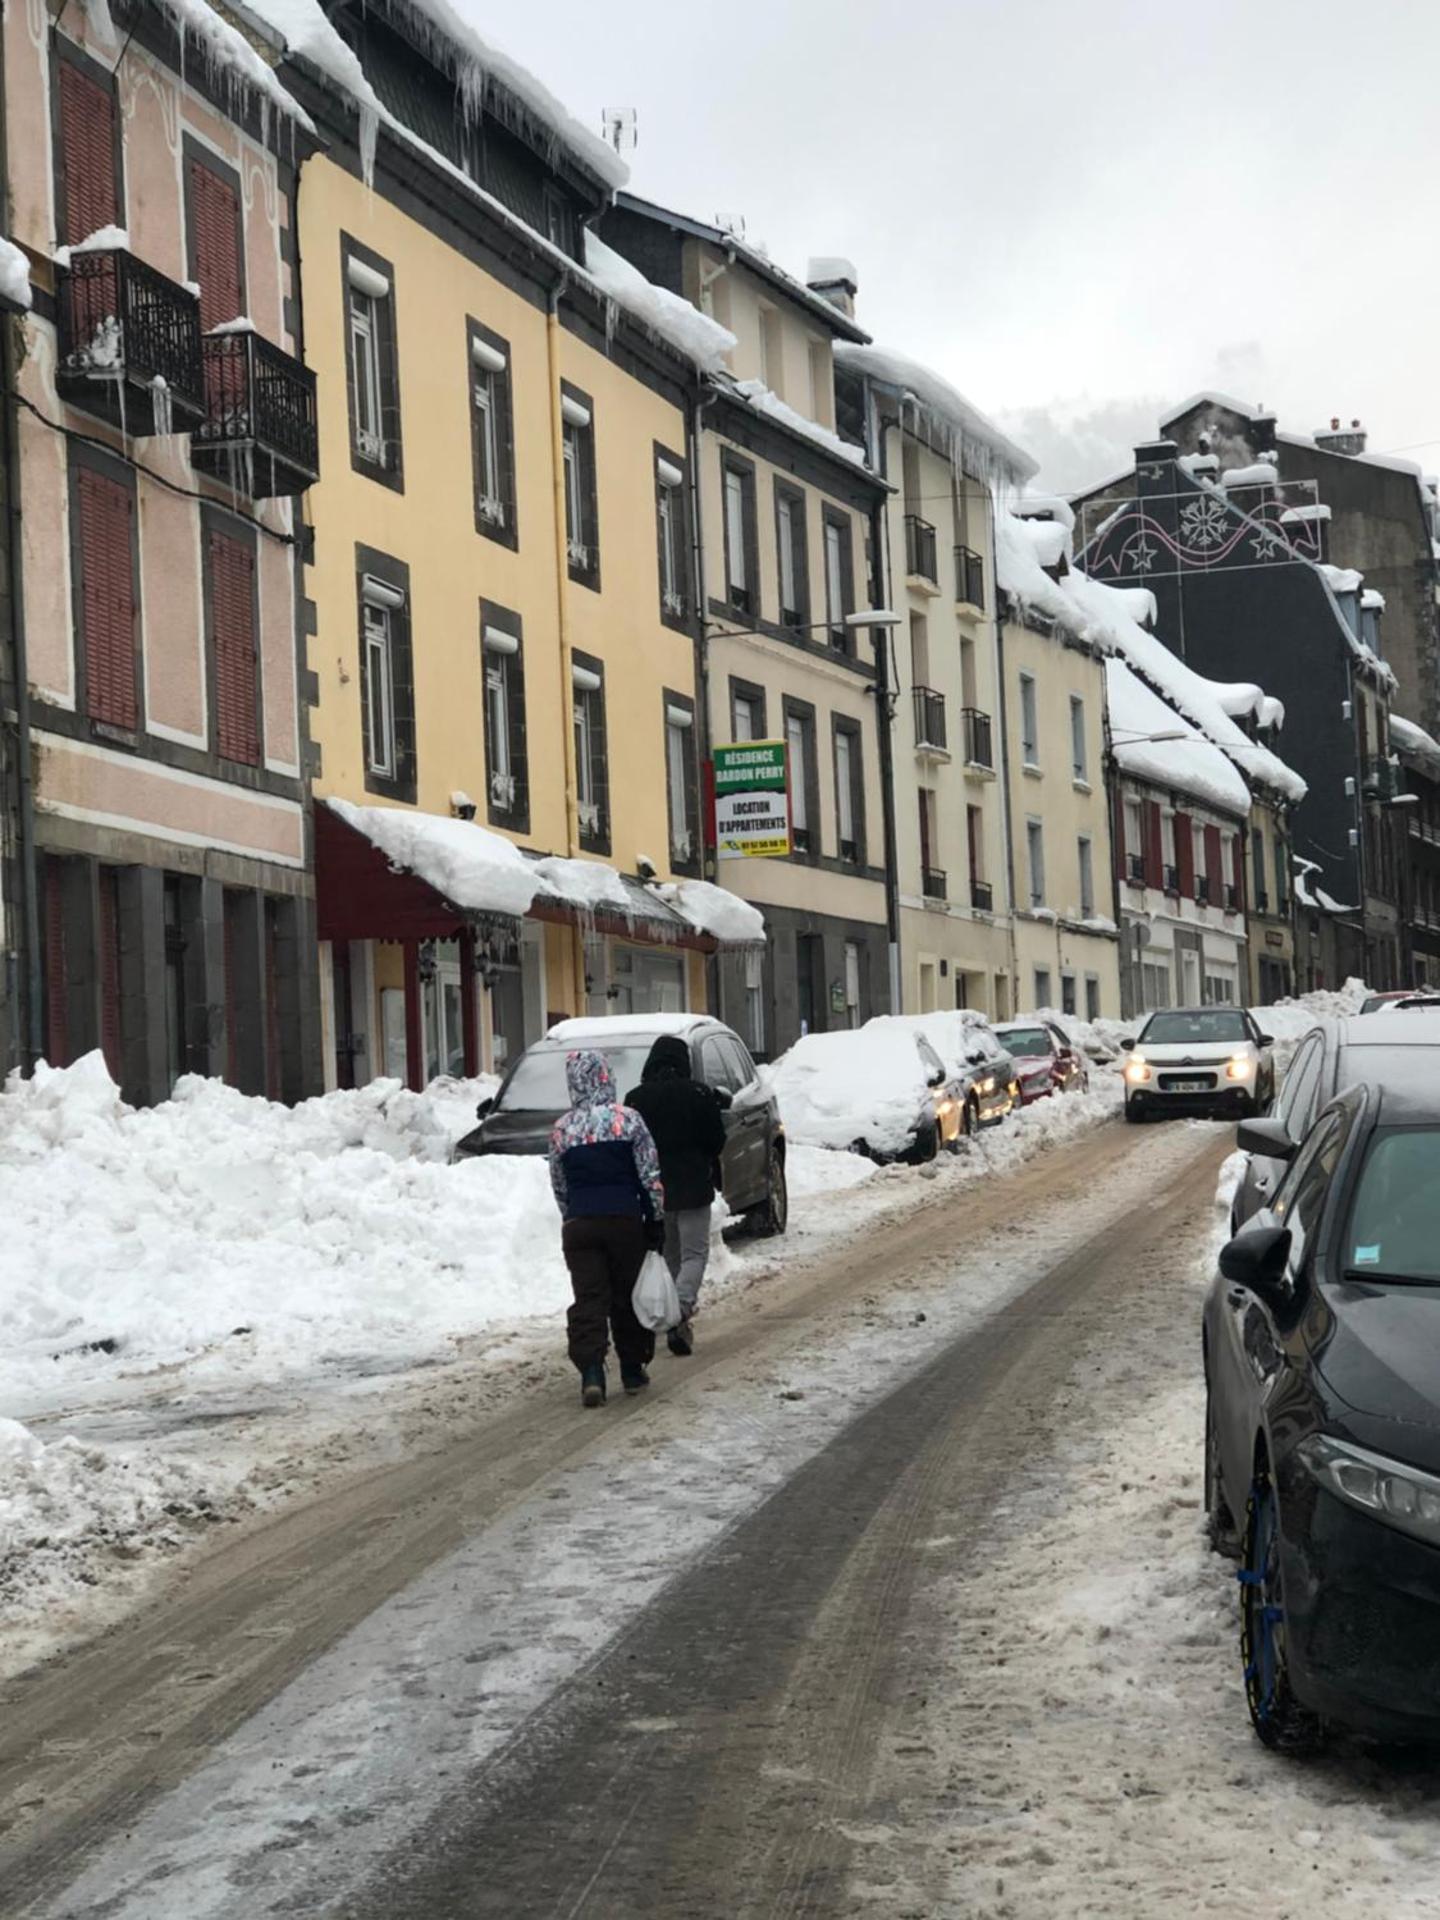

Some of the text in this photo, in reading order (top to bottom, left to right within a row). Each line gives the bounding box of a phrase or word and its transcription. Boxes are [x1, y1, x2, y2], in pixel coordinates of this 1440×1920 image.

[725, 750, 774, 766] RÉSIDENCE
[733, 801, 770, 815] LOCATION
[719, 816, 786, 833] D'APPARTEMENTS
